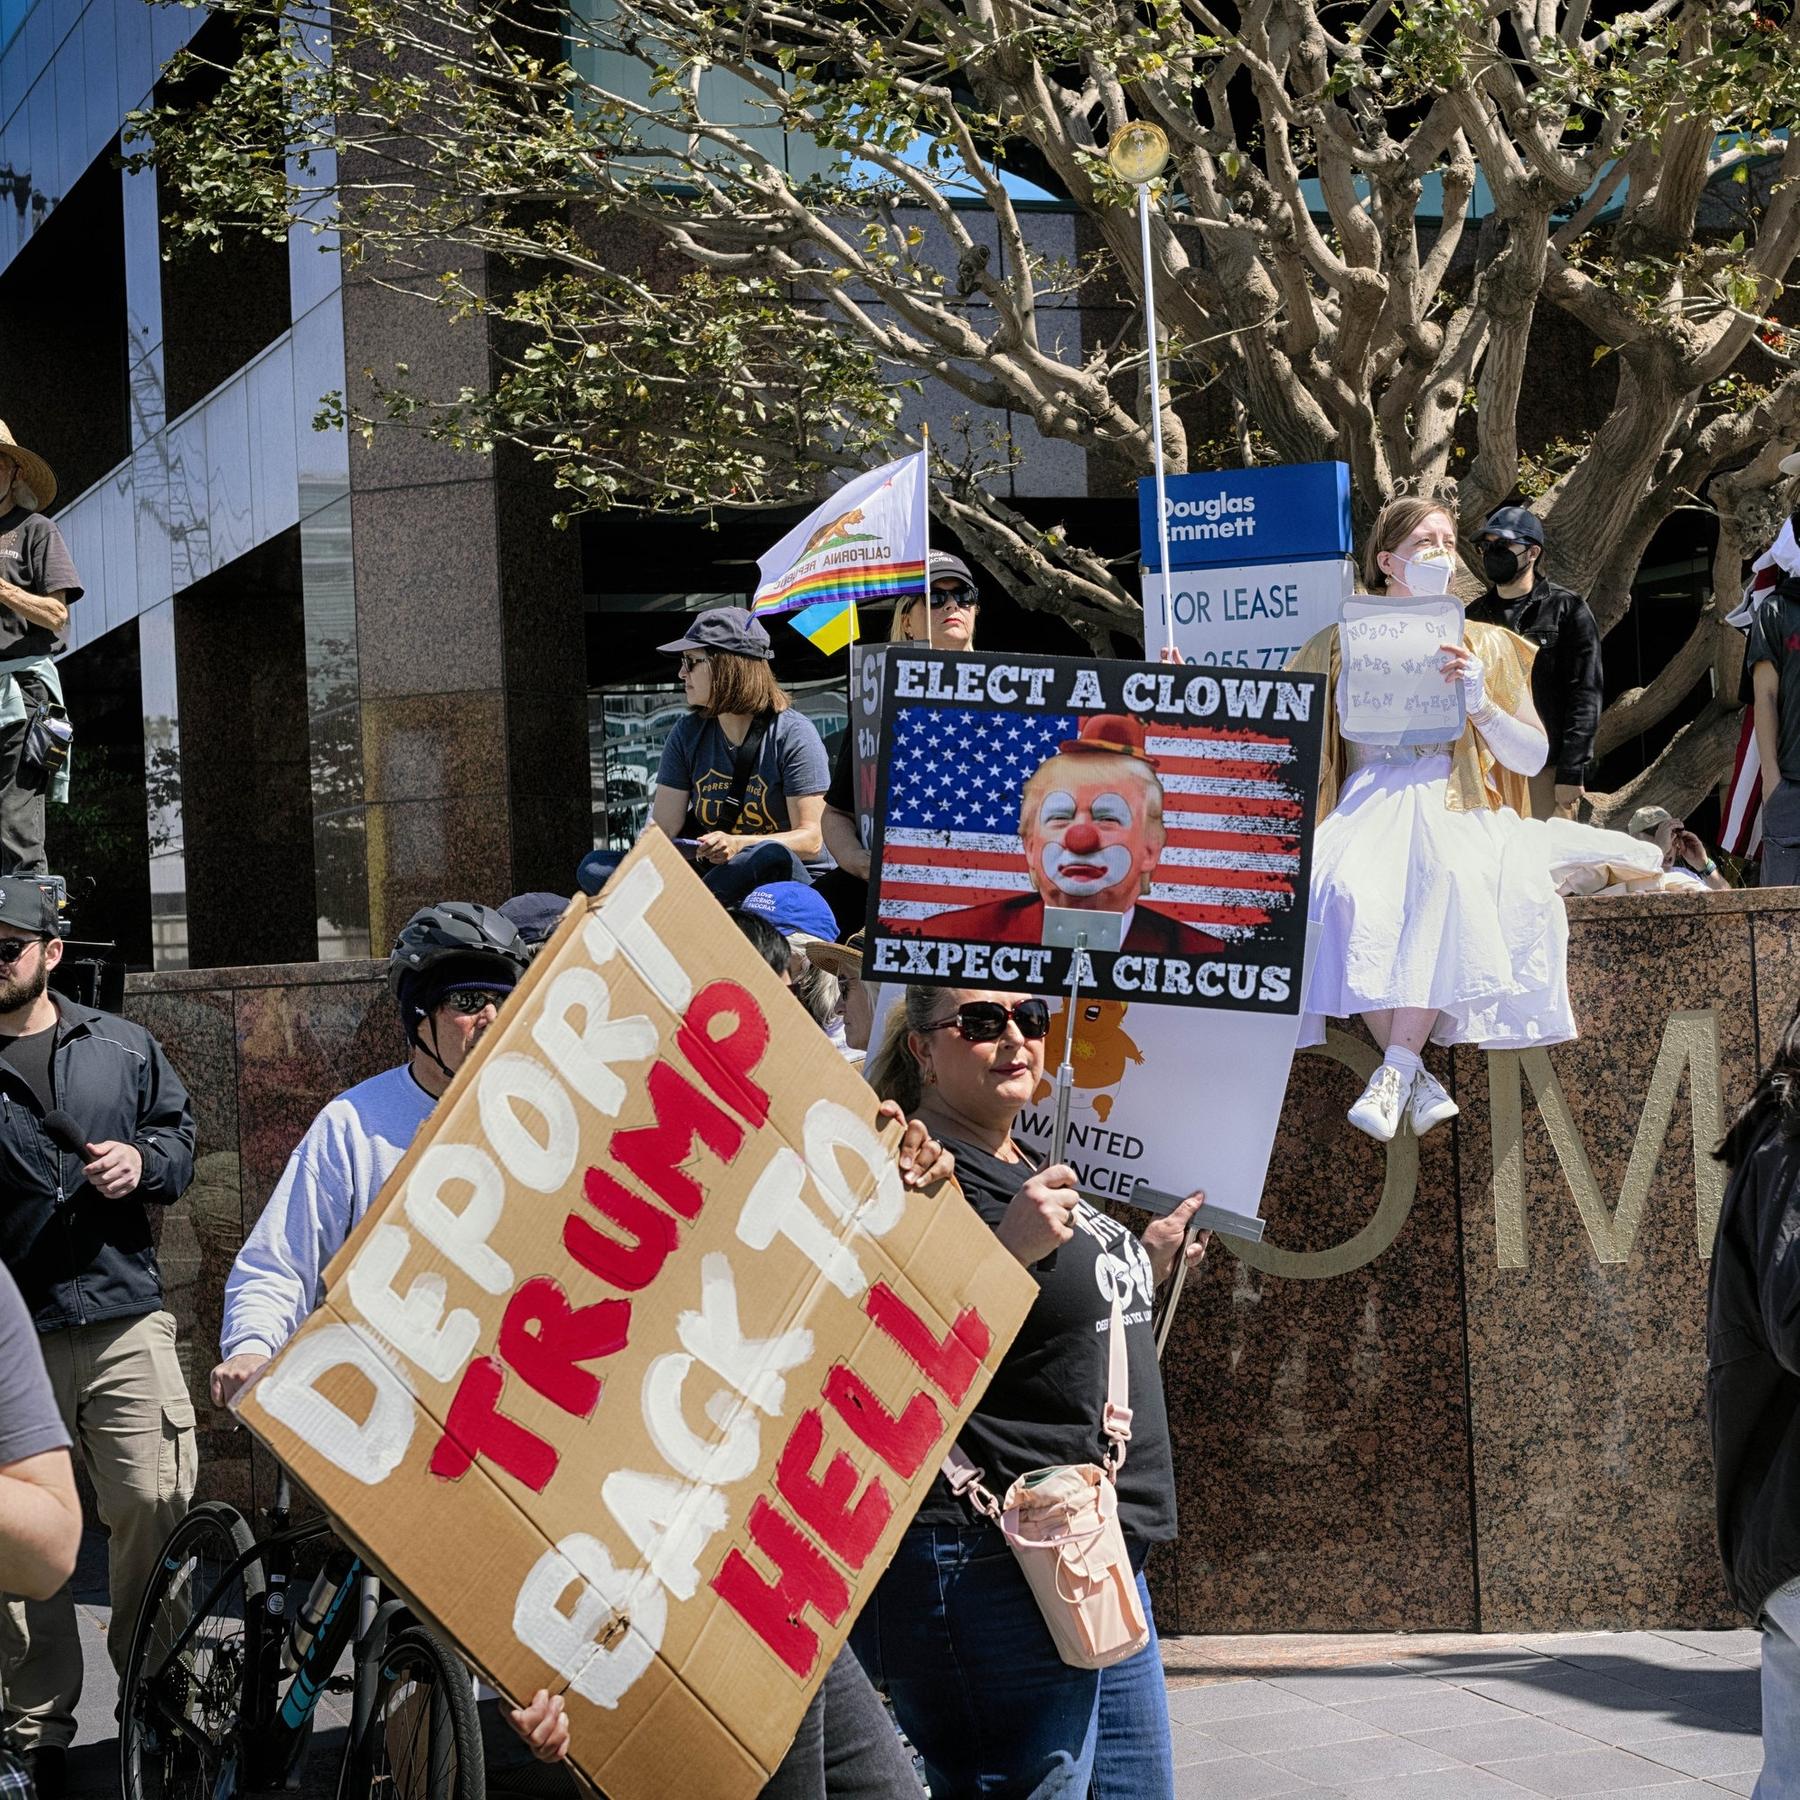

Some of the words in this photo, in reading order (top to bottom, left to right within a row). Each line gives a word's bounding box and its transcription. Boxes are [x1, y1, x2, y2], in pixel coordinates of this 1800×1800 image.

[1223, 584, 1299, 622] LEASE
[1425, 621, 1447, 638] ON
[893, 660, 1055, 706] ELECT
[1066, 669, 1106, 710] A
[1122, 672, 1315, 723] CLOWN
[702, 782, 732, 793] FORES
[872, 937, 1053, 984] EXPECT
[1062, 950, 1098, 988] A
[1112, 957, 1292, 1002] CIRCUS
[256, 857, 693, 1485] DEPORT
[429, 977, 771, 1494] TRUMP
[511, 1251, 815, 1711] BACK
[735, 1099, 907, 1298] TO
[711, 1280, 995, 1680] HELL
